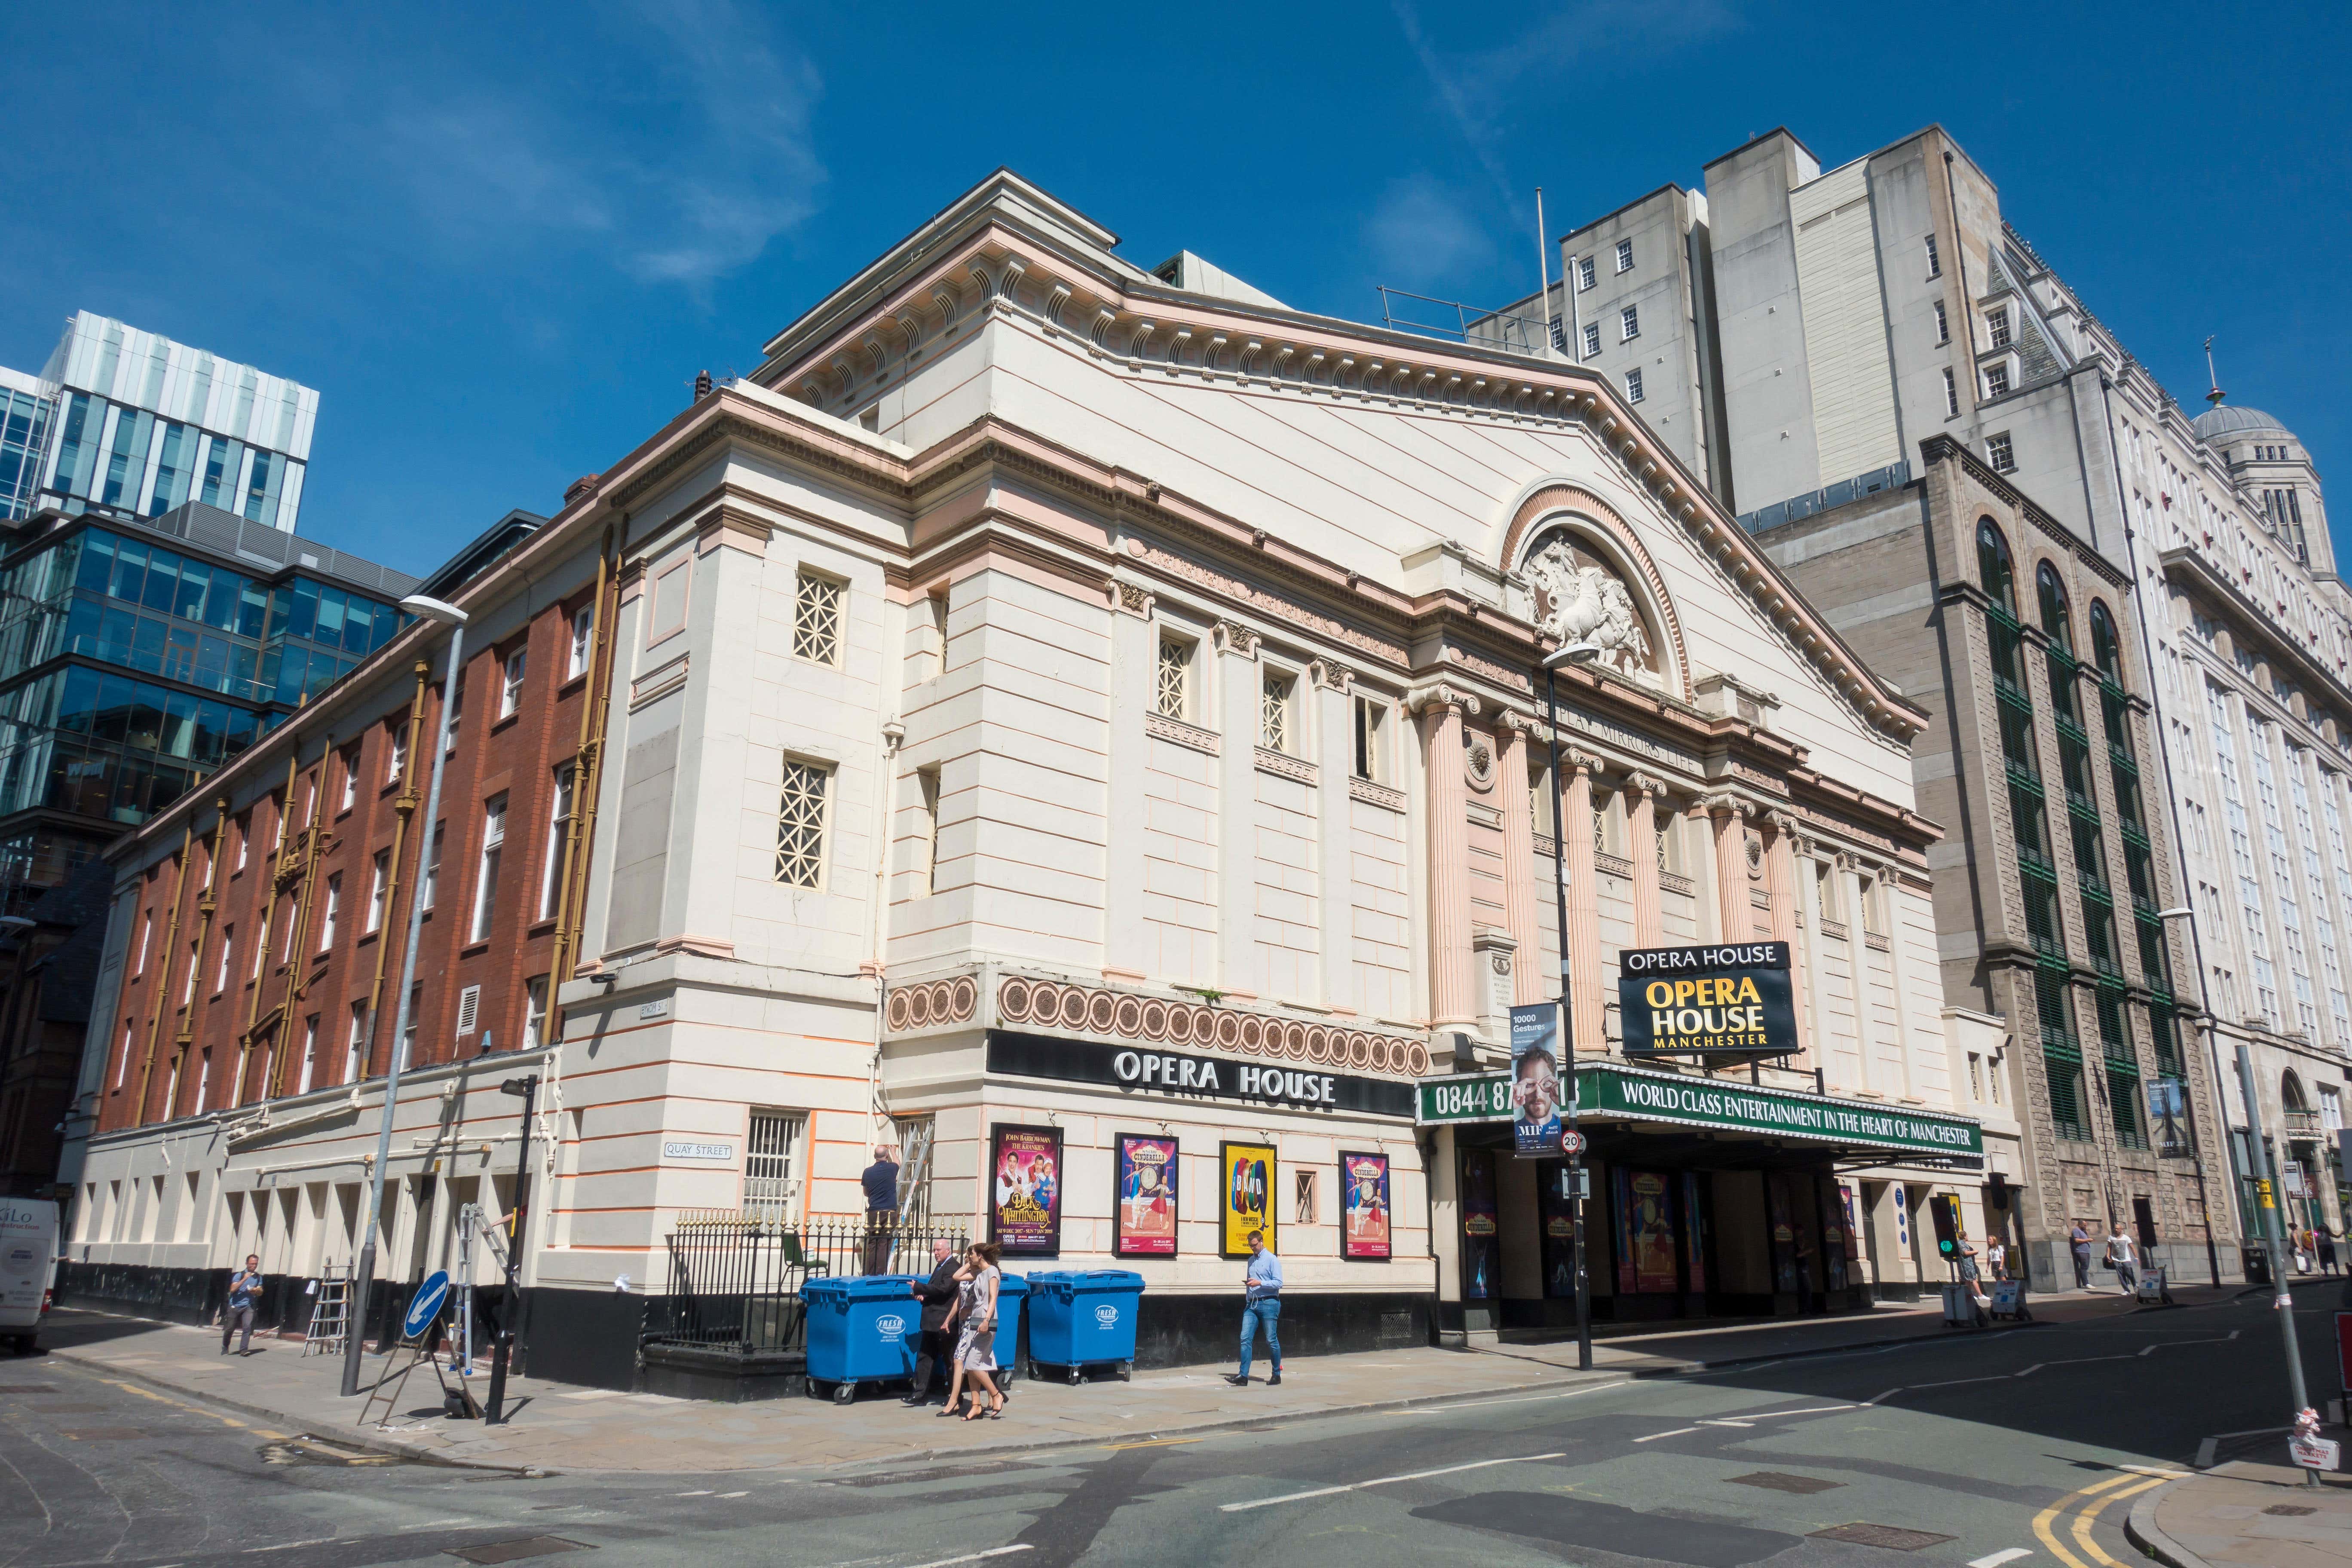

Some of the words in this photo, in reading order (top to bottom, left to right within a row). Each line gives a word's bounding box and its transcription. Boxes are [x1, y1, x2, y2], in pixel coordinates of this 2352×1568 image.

[1559, 704, 1592, 732] PLAY
[1601, 720, 1660, 758] MIRRORS
[1666, 746, 1694, 772] LIFE
[1629, 951, 1698, 970] OPERA
[1703, 946, 1777, 965] HOUSE
[1646, 977, 1762, 1008] OPERA
[1513, 1014, 1536, 1023] 10000
[1652, 1005, 1764, 1035] HOUSE
[1513, 1023, 1545, 1032] Gestures
[1654, 1034, 1768, 1049] MANCHESTER
[1114, 1052, 1219, 1089] OPERA
[1240, 1066, 1336, 1102] HOUSE
[1436, 1083, 1488, 1114] 0844
[1622, 1081, 1678, 1109] WORLD
[1681, 1090, 1721, 1115] CLASS
[1724, 1096, 1822, 1128] ENTERTAINMENT
[1824, 1111, 1837, 1130] IN
[1837, 1112, 1859, 1132] THE
[1861, 1115, 1893, 1136] HEART
[1895, 1120, 1908, 1138] OF
[1911, 1122, 1971, 1145] MANCHESTER
[1006, 1133, 1019, 1142] JOHN
[1020, 1135, 1051, 1143] BARROWMAN
[1519, 1125, 1543, 1136] MIF
[1564, 1136, 1577, 1146] 20
[668, 1144, 692, 1154] QUAY
[696, 1145, 729, 1155] STREET
[1134, 1153, 1165, 1162] CINDERELLA
[1237, 1175, 1262, 1195] BAND
[1012, 1192, 1041, 1210] DICK
[998, 1206, 1051, 1228] WHITTINGTON
[1468, 1223, 1493, 1231] CINDERELLA
[879, 1319, 903, 1327] FRESH
